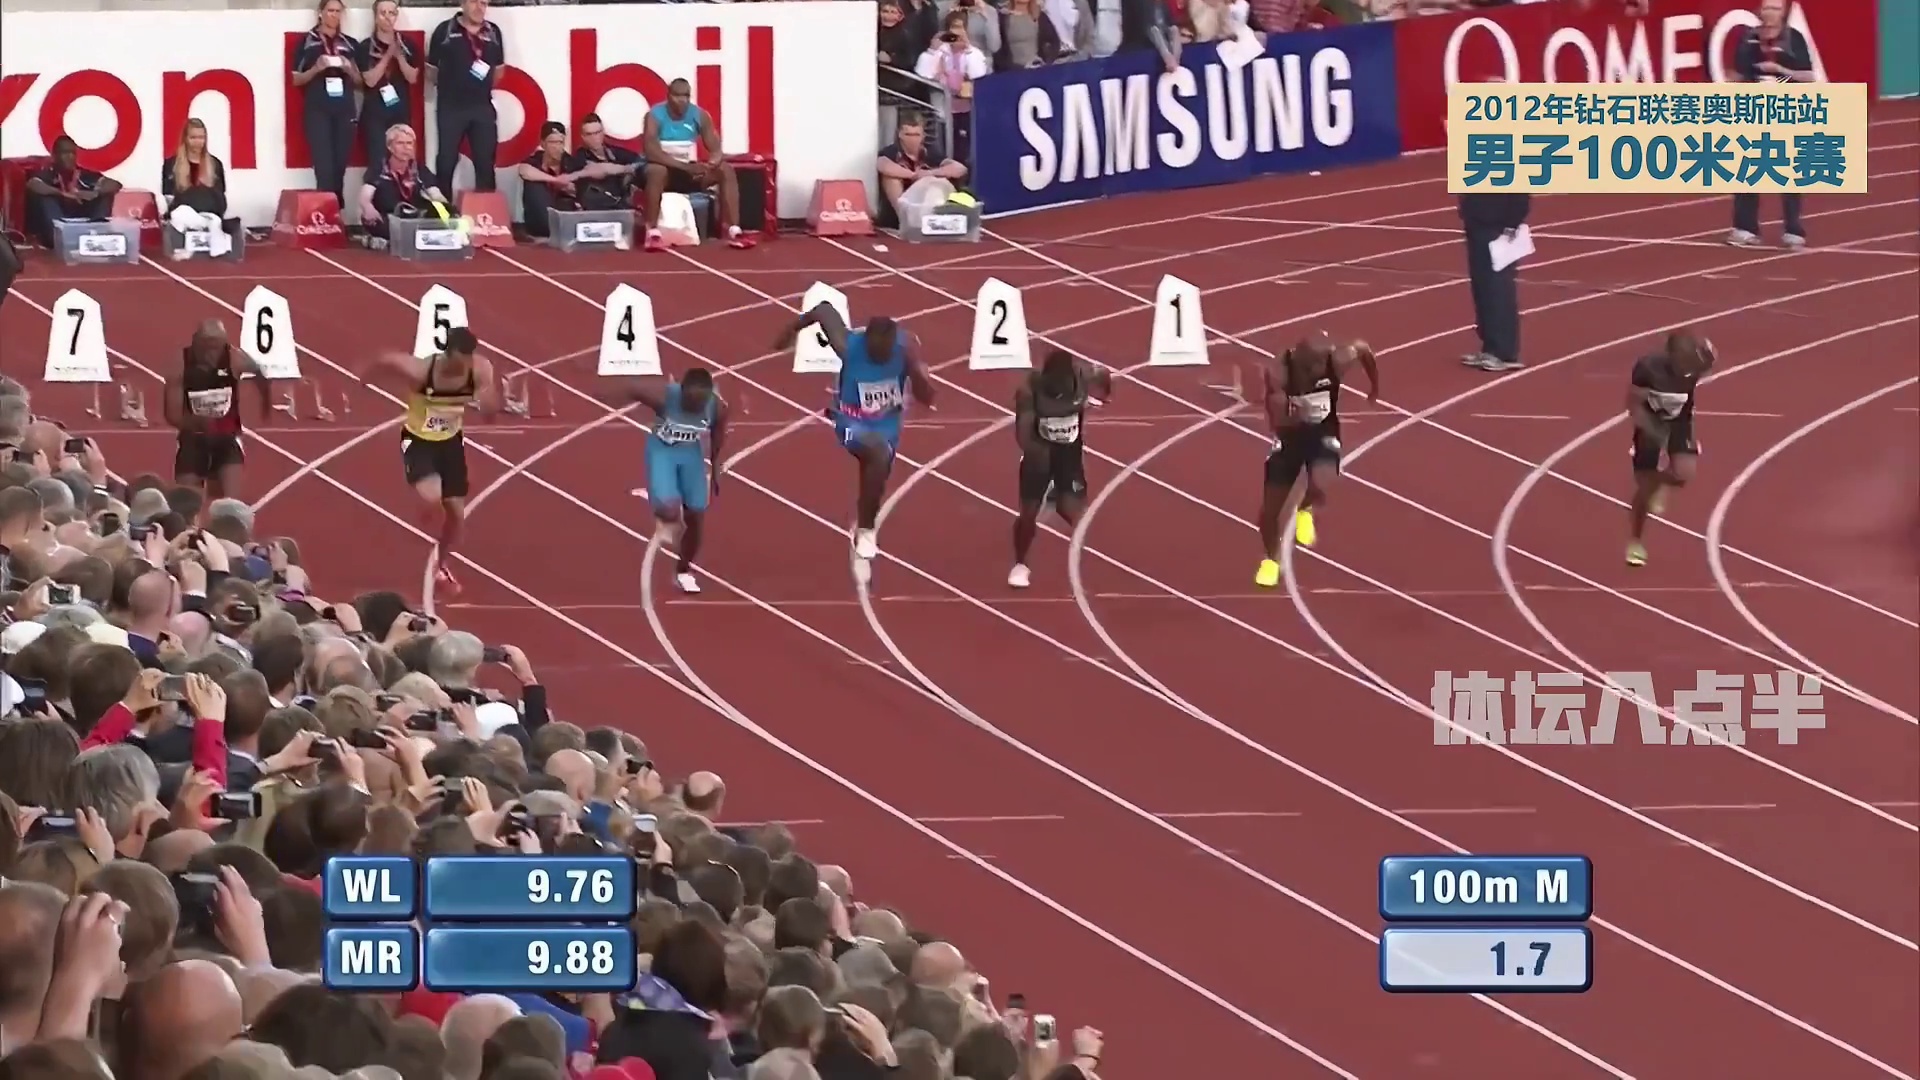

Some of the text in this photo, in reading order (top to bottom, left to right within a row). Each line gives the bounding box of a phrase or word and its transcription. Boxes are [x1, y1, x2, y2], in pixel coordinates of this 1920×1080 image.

[1018, 47, 1354, 190] SAMSUNG
[67, 308, 85, 356] 7
[256, 306, 274, 354] 6
[433, 303, 451, 350] 5
[616, 305, 636, 351] 4
[991, 299, 1009, 345] 2
[1170, 293, 1182, 338] 1
